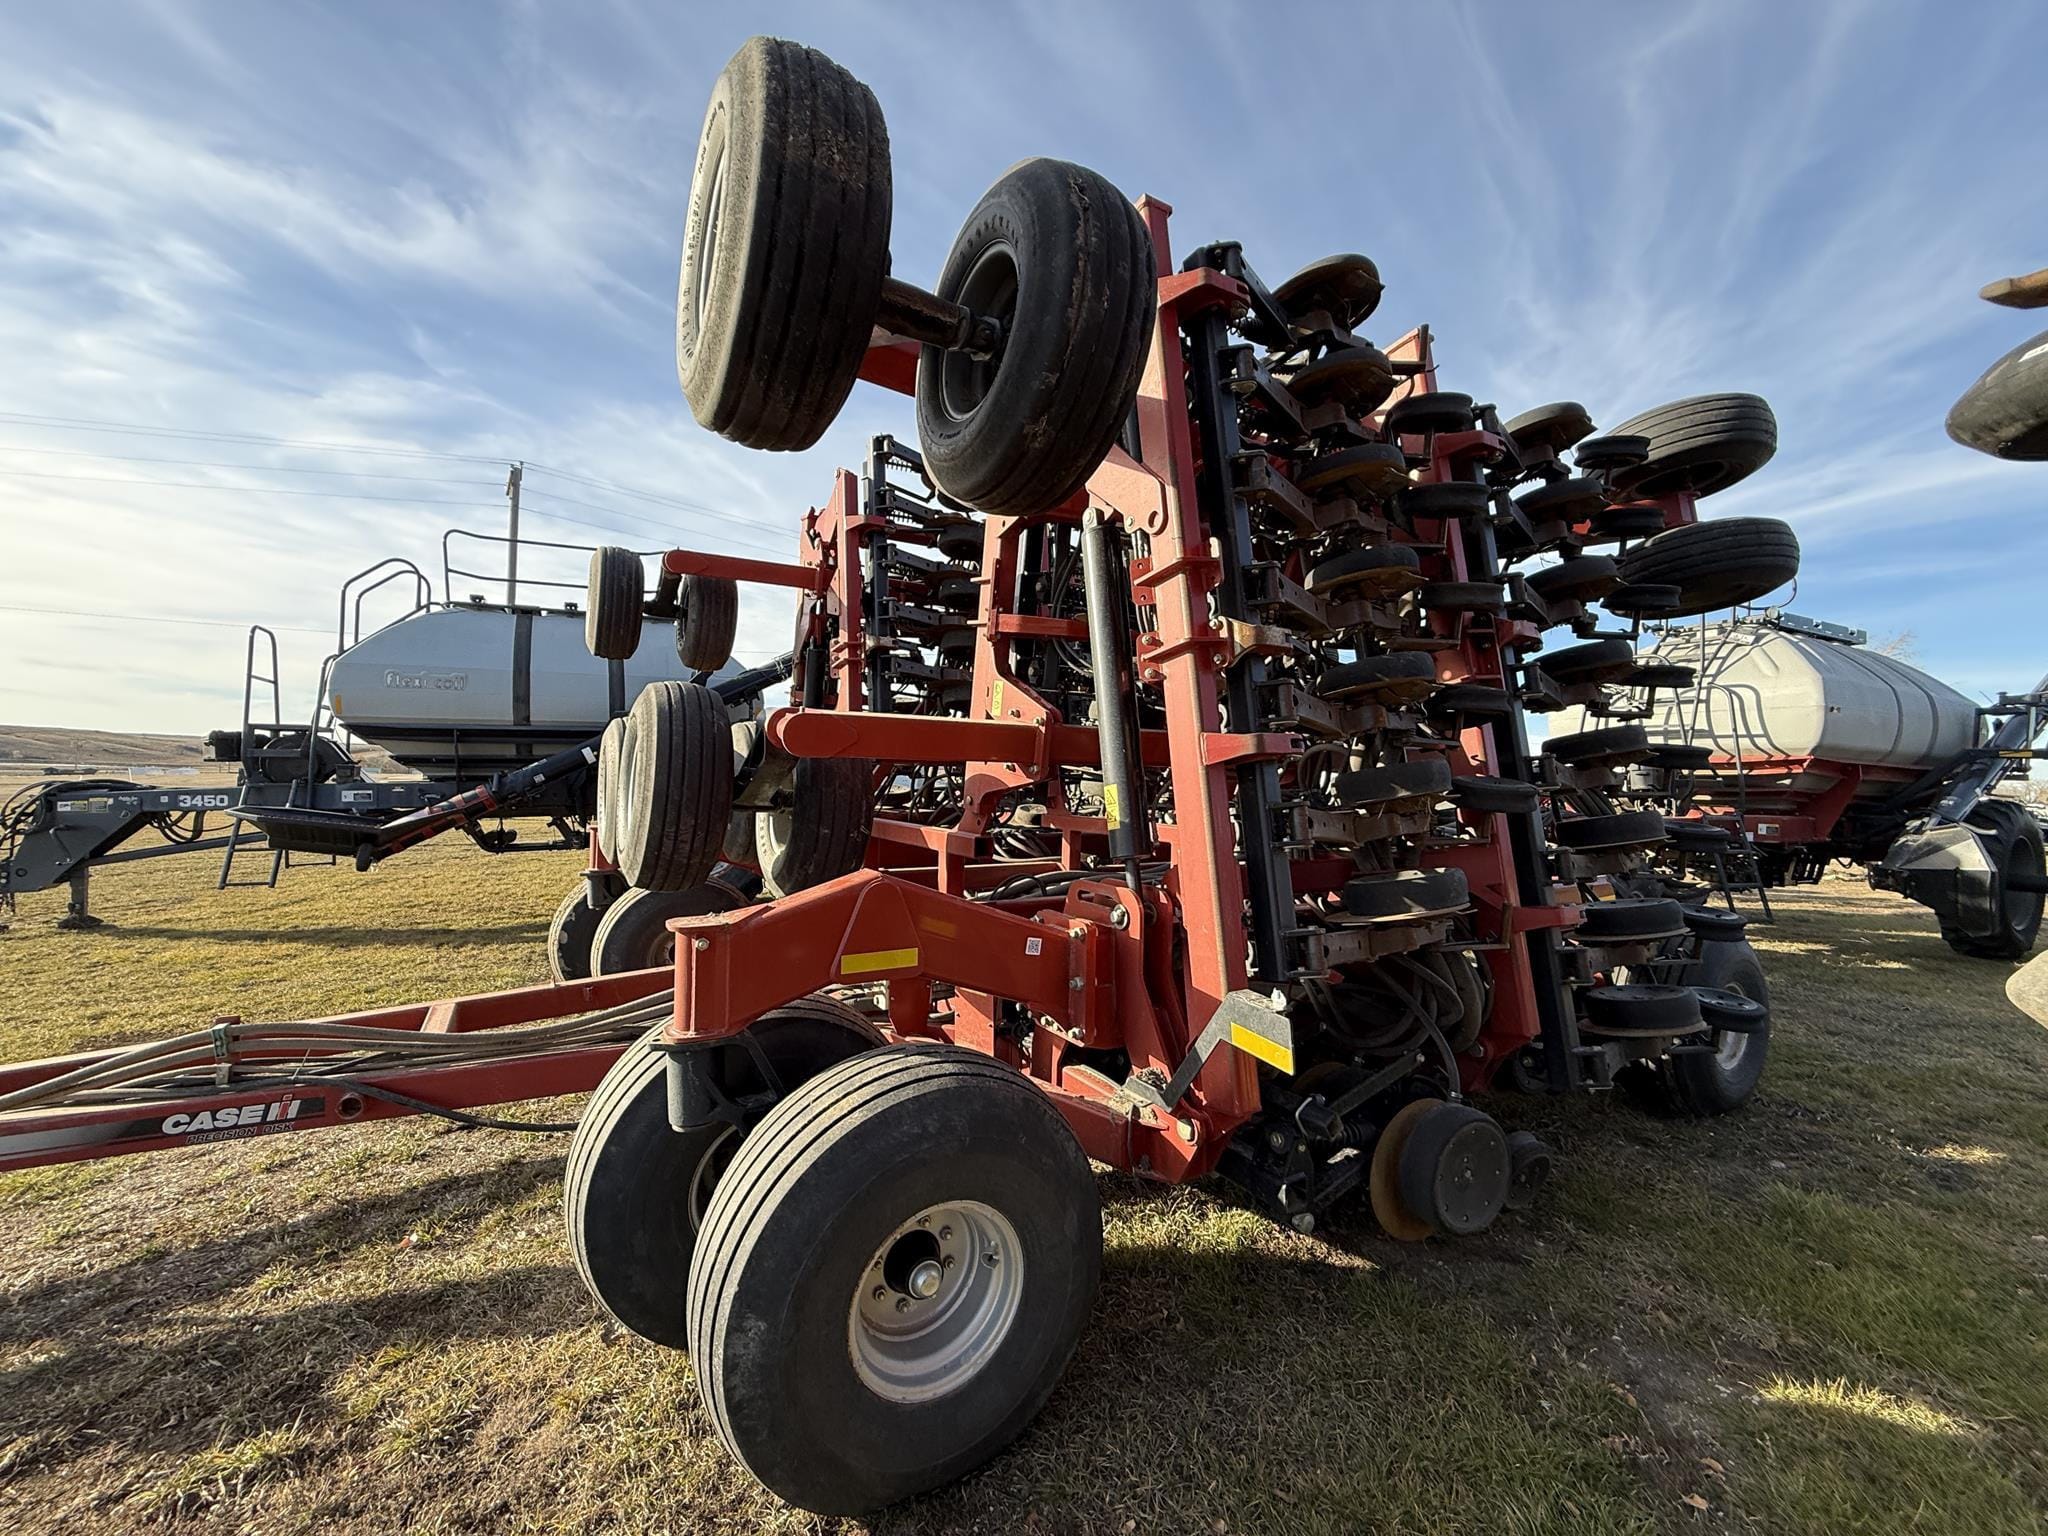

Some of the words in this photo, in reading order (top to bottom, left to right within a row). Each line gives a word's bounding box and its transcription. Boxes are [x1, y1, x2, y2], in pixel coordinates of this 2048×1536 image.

[178, 794, 229, 808] 3450
[186, 1126, 258, 1145] PRECISION
[262, 1121, 295, 1134] DISK
